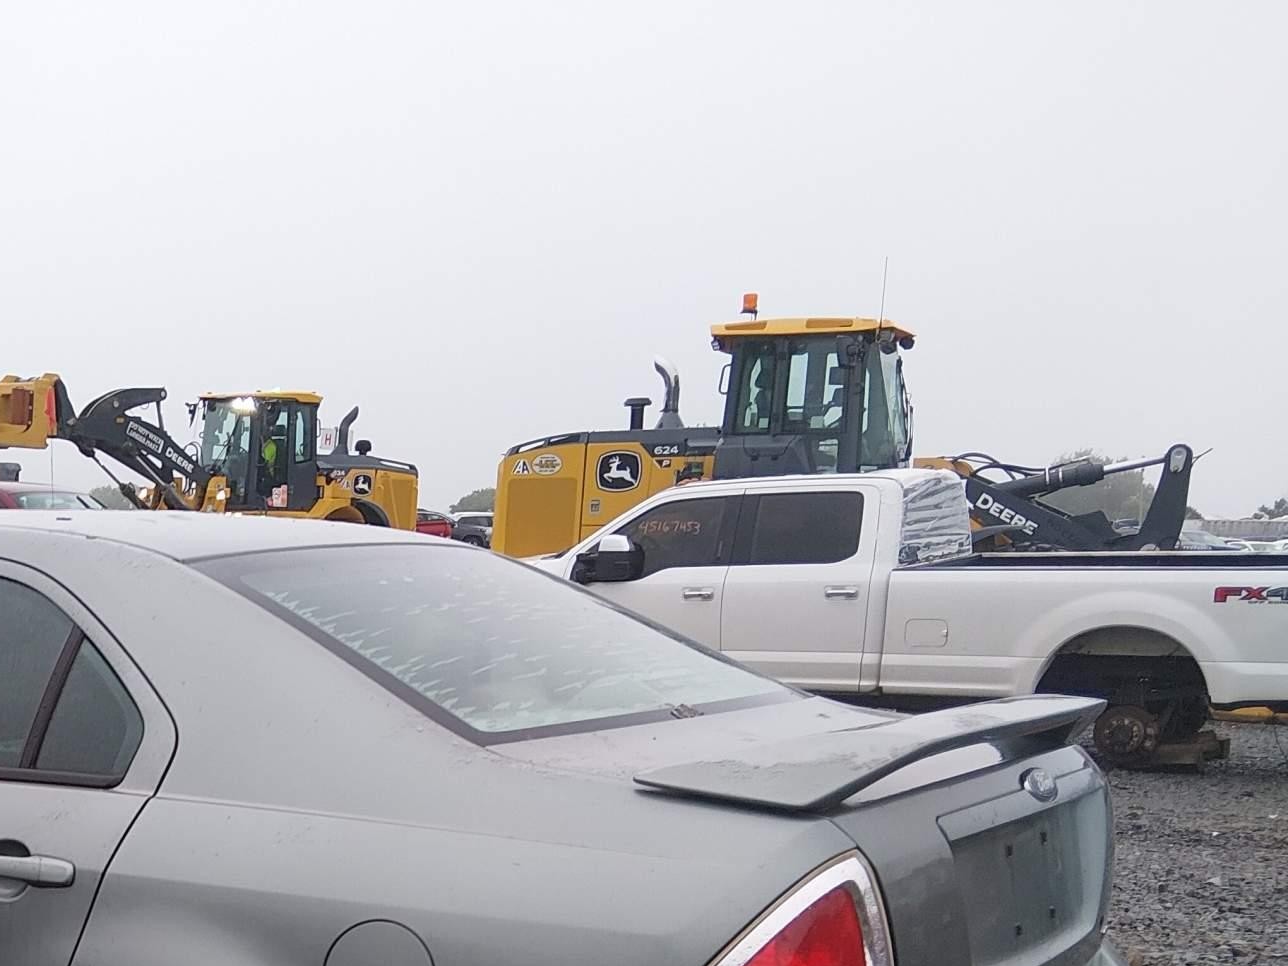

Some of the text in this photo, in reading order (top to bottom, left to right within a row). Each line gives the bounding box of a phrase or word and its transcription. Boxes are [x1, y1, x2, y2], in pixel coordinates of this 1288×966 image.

[324, 434, 332, 446] H
[165, 446, 194, 474] DEERE
[654, 446, 679, 455] 624
[975, 492, 1039, 536] DEERE
